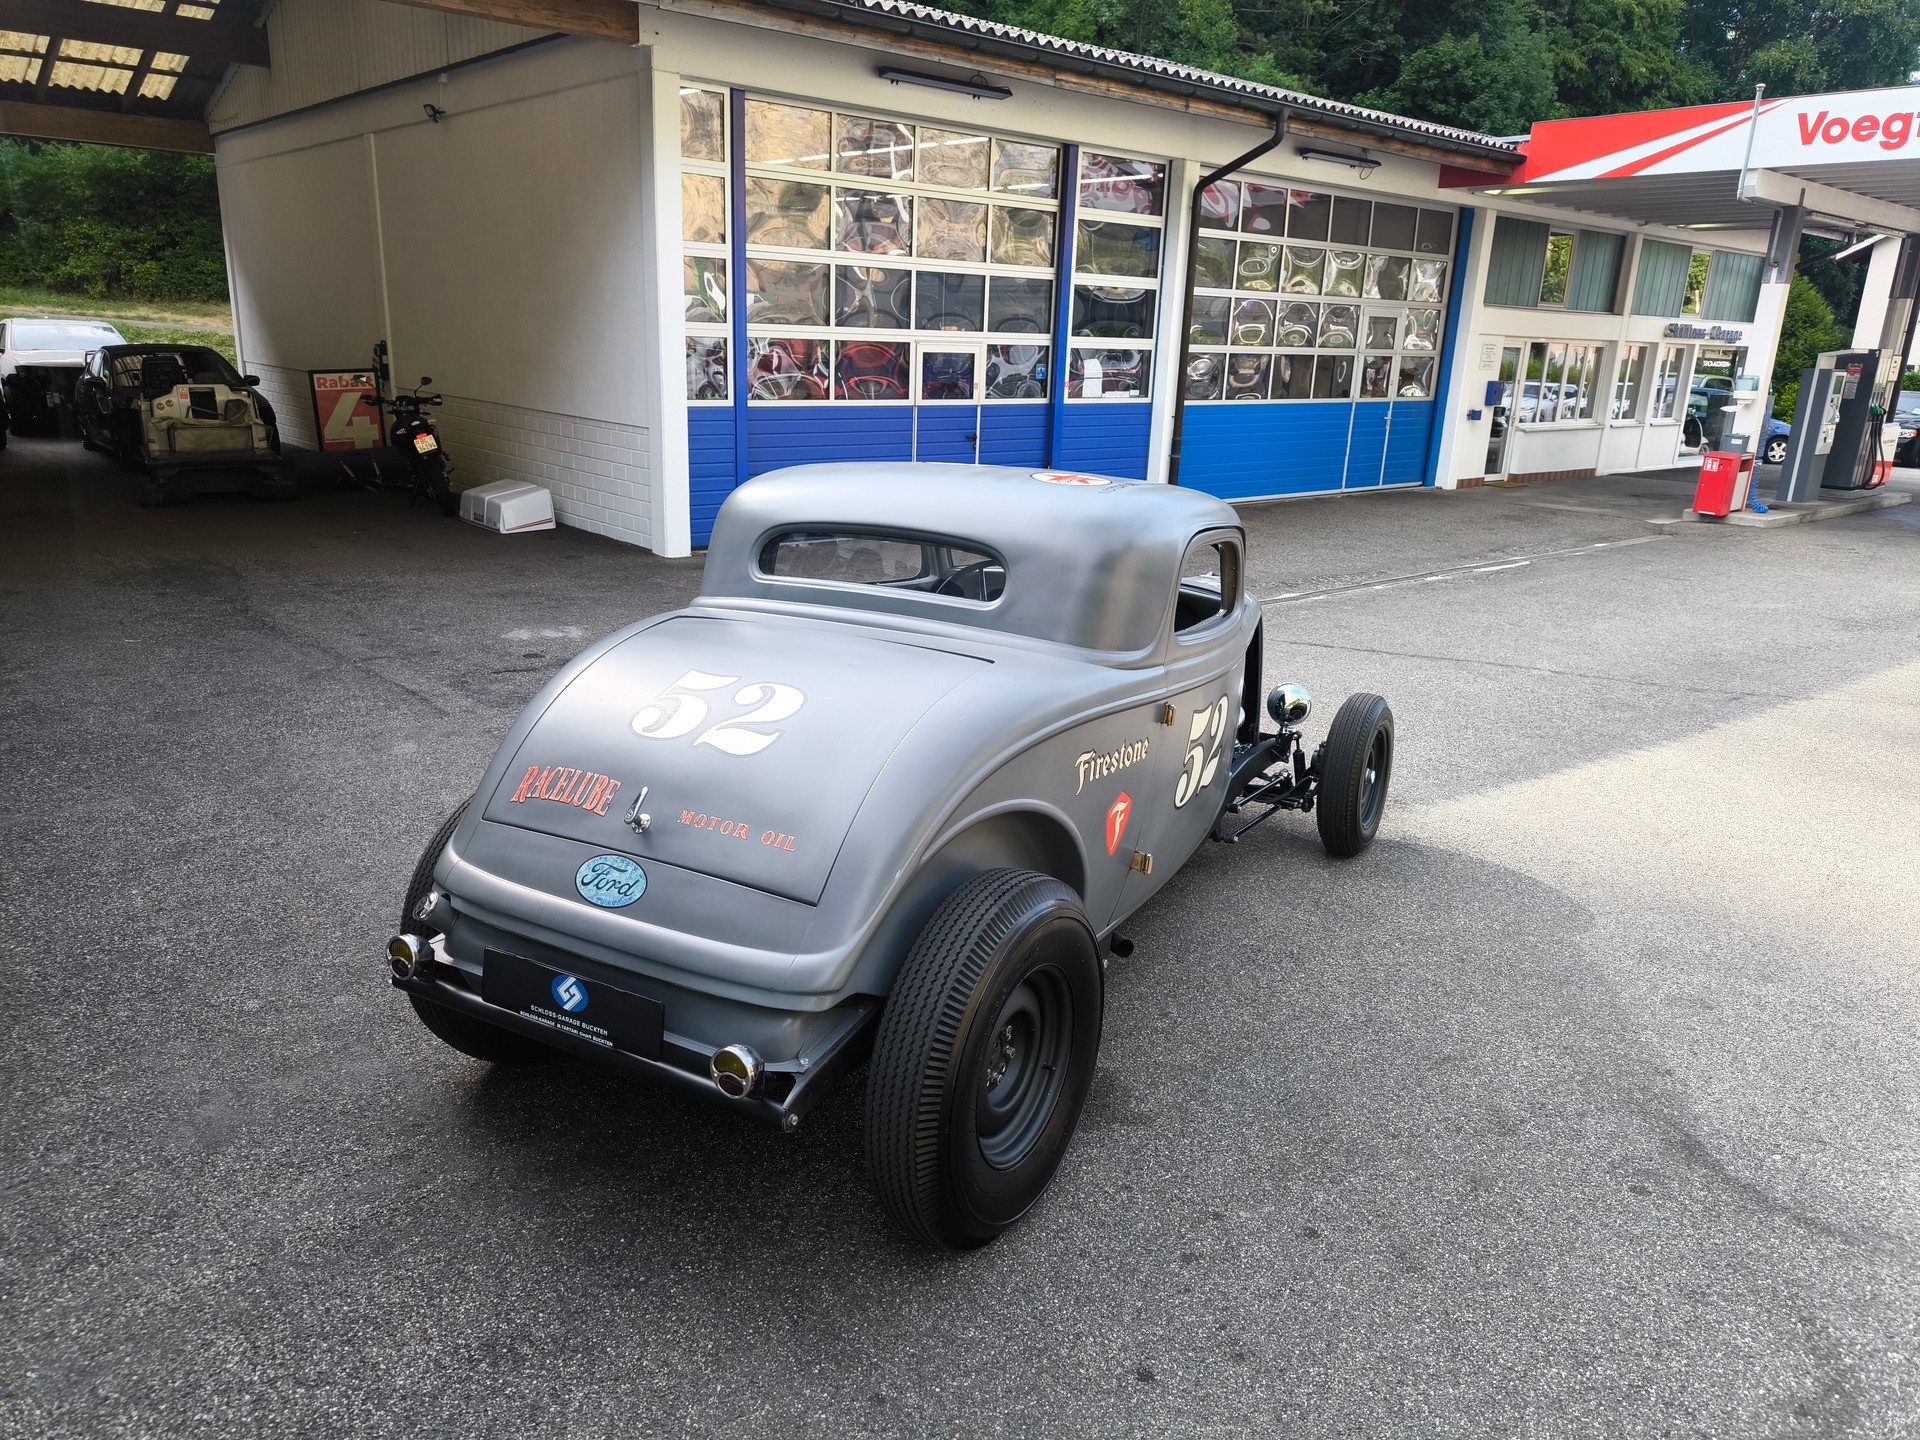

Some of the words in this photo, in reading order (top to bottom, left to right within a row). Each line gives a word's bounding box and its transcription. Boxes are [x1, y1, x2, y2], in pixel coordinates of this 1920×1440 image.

[1798, 110, 1920, 151] Voeg
[323, 391, 380, 449] 4
[628, 668, 808, 758] 52
[1074, 736, 1150, 796] Firestone
[1174, 693, 1229, 810] 52
[510, 765, 622, 818] RACELUBE
[677, 808, 751, 841] MOTOR
[760, 830, 798, 853] OIL
[581, 861, 639, 899] Ford
[530, 1004, 580, 1026] SCHLOSS-GARAGE
[581, 1022, 608, 1036] BUCKTEN
[592, 1036, 614, 1047] BUCKTEN
